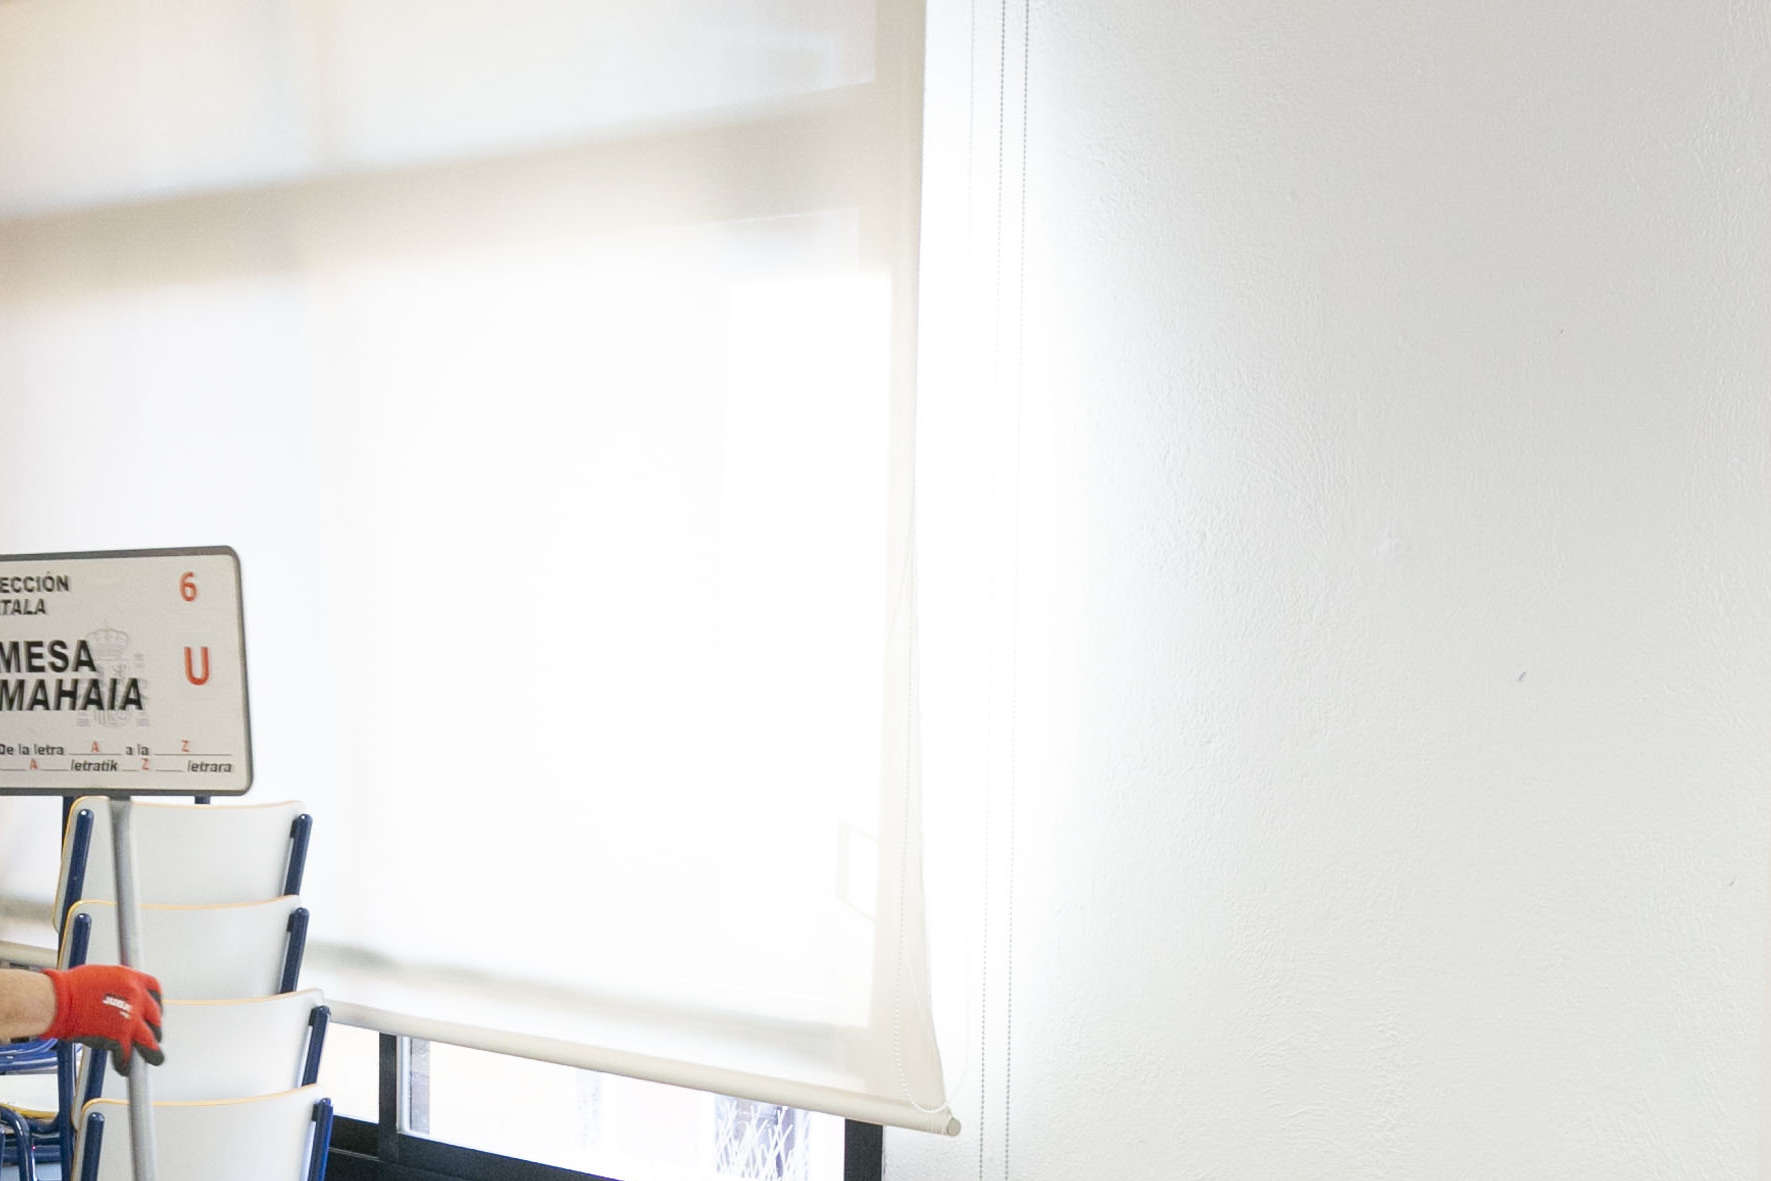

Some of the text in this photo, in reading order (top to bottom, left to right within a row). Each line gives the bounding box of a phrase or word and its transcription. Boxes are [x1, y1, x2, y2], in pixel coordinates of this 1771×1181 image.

[180, 572, 198, 602] 6
[184, 646, 210, 686] U
[18, 744, 30, 755] la
[34, 744, 64, 755] letra
[91, 741, 99, 752] A
[126, 747, 135, 756] a
[137, 744, 149, 756] la
[181, 740, 189, 752] Z
[30, 759, 232, 772] A letratik Z letrara
